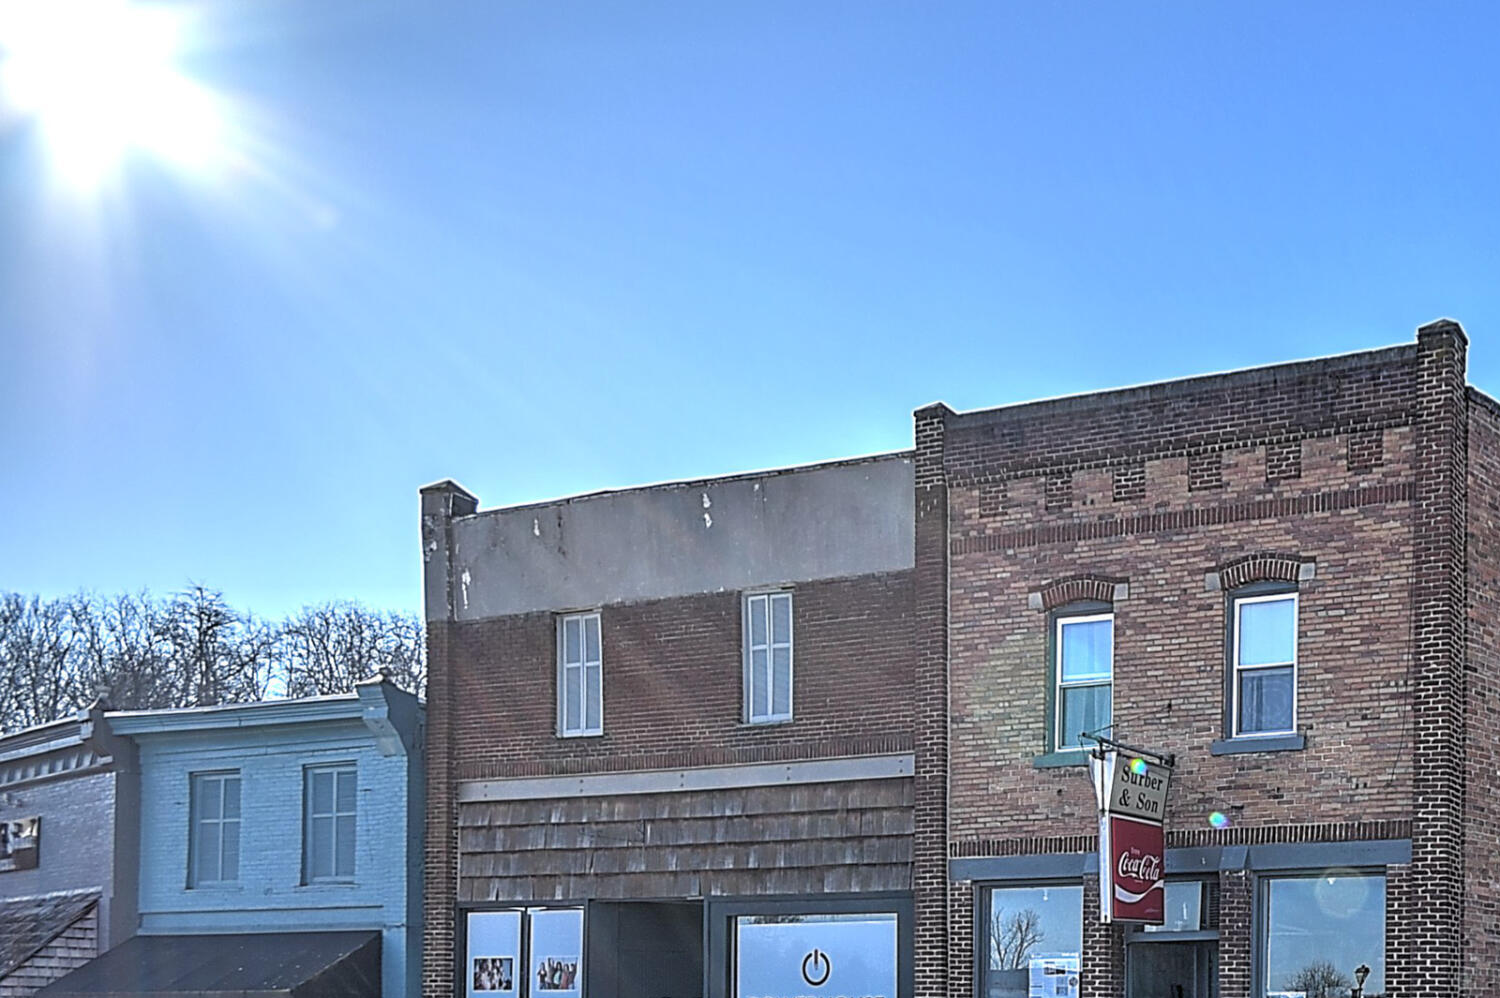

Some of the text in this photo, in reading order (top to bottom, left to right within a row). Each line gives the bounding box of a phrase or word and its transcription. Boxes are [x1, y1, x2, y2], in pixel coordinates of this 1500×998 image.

[1121, 764, 1164, 791] Surber
[1119, 788, 1159, 814] & Son
